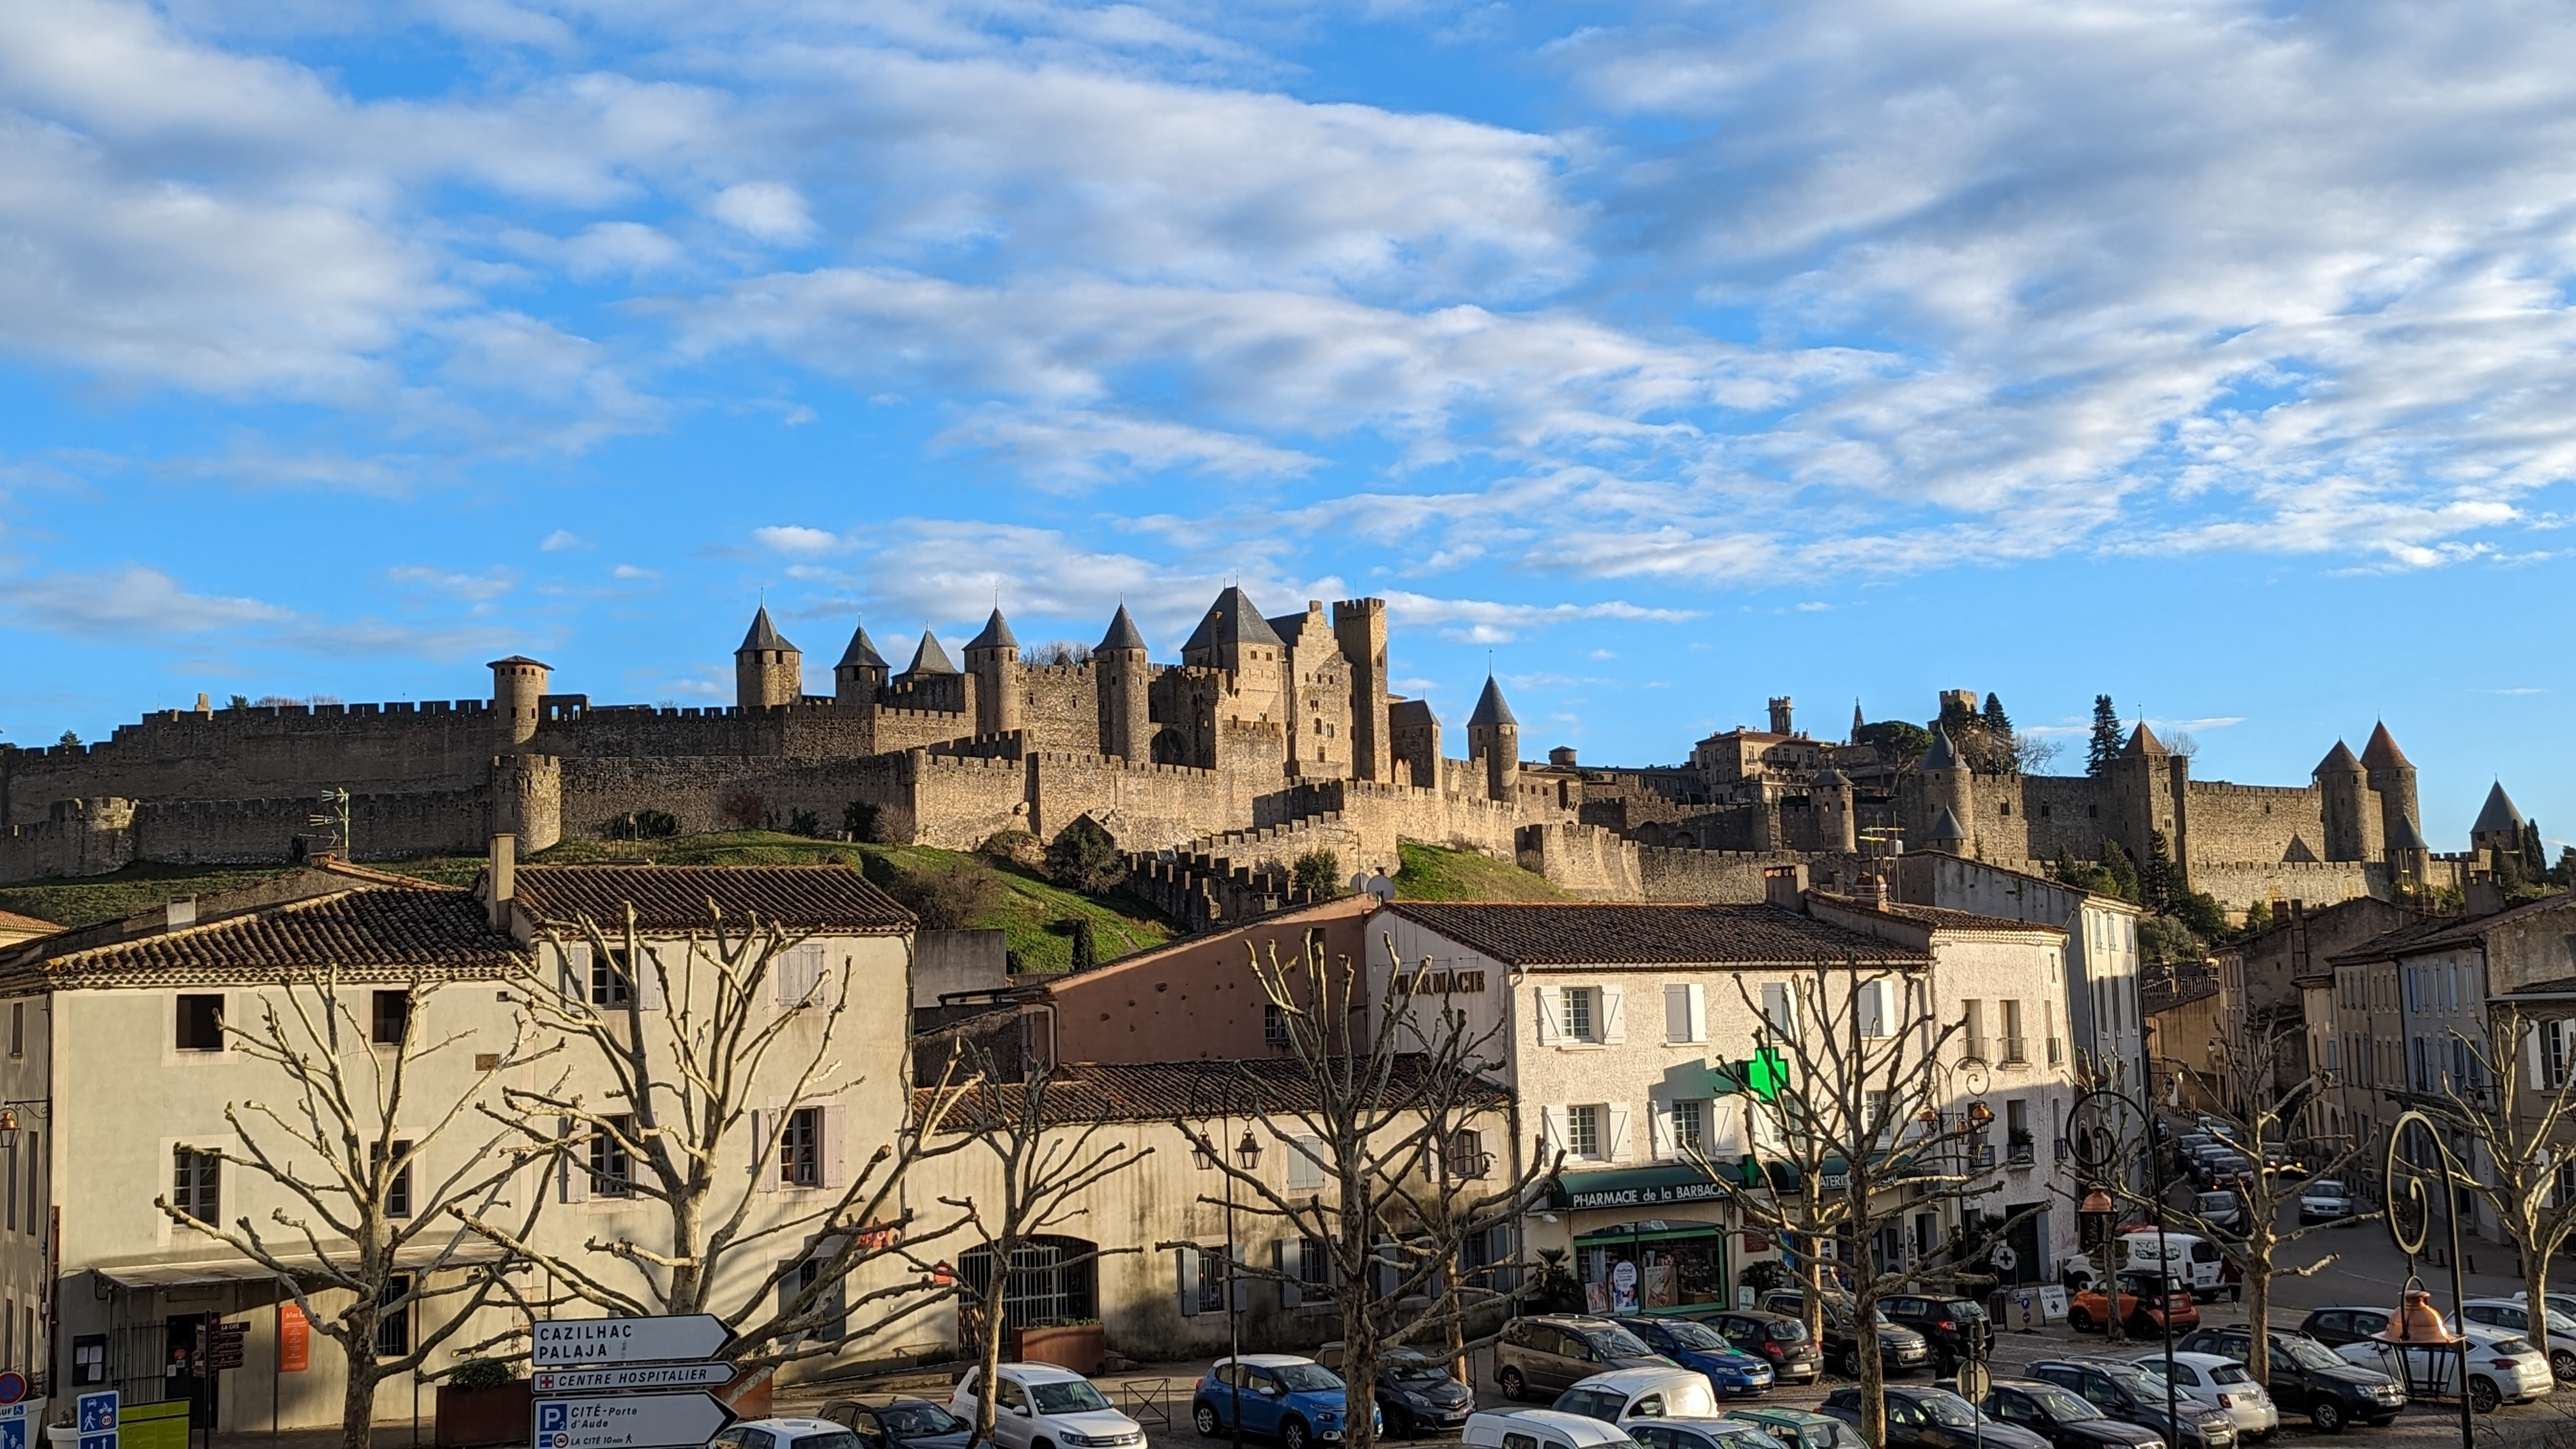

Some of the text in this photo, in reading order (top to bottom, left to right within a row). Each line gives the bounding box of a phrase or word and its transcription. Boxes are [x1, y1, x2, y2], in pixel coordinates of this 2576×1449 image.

[1573, 1182, 1739, 1208] PHARMACIE de la BARBACA
[540, 1324, 632, 1340] CAZILHAC
[539, 1344, 607, 1360] PALAJA
[559, 1369, 707, 1386] CENTRE HOSPITALIER
[571, 1419, 608, 1429] d'Aude
[583, 1435, 601, 1445] CITÉ
